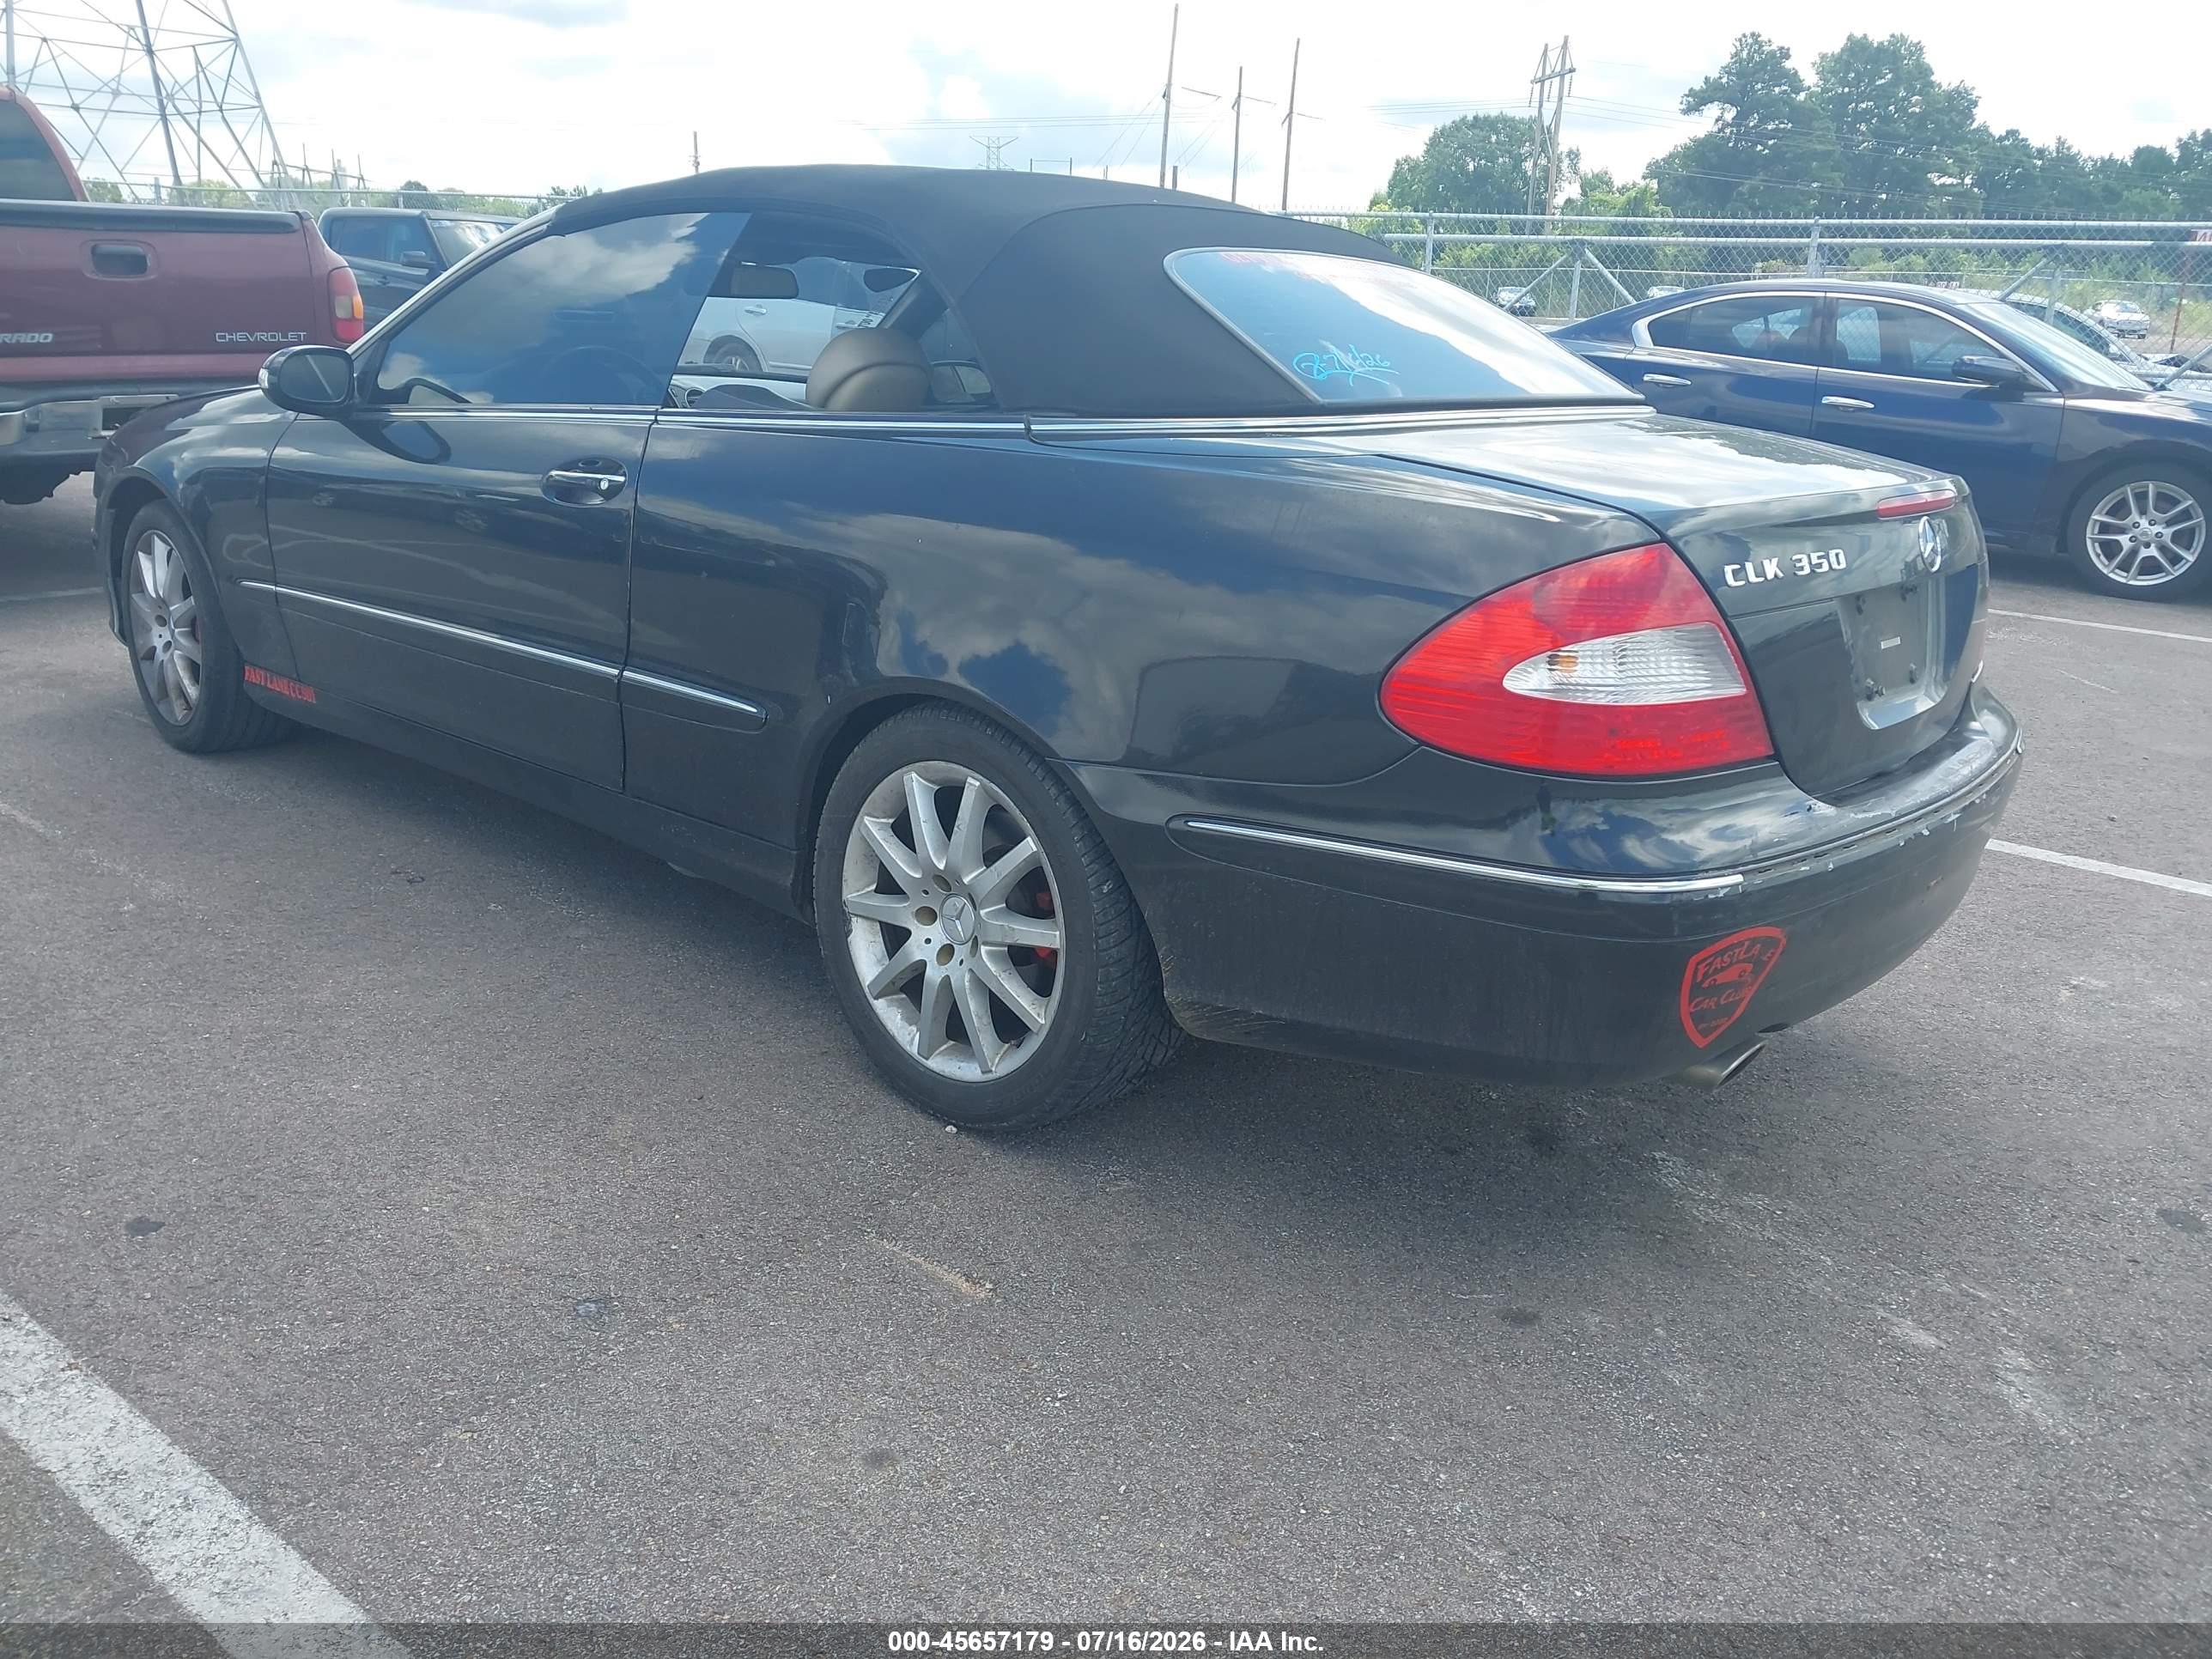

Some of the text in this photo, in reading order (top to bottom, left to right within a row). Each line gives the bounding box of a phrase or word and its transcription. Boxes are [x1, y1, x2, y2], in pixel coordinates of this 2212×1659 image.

[214, 331, 307, 343] CHEVROLET
[1723, 548, 1847, 588] CLK 350
